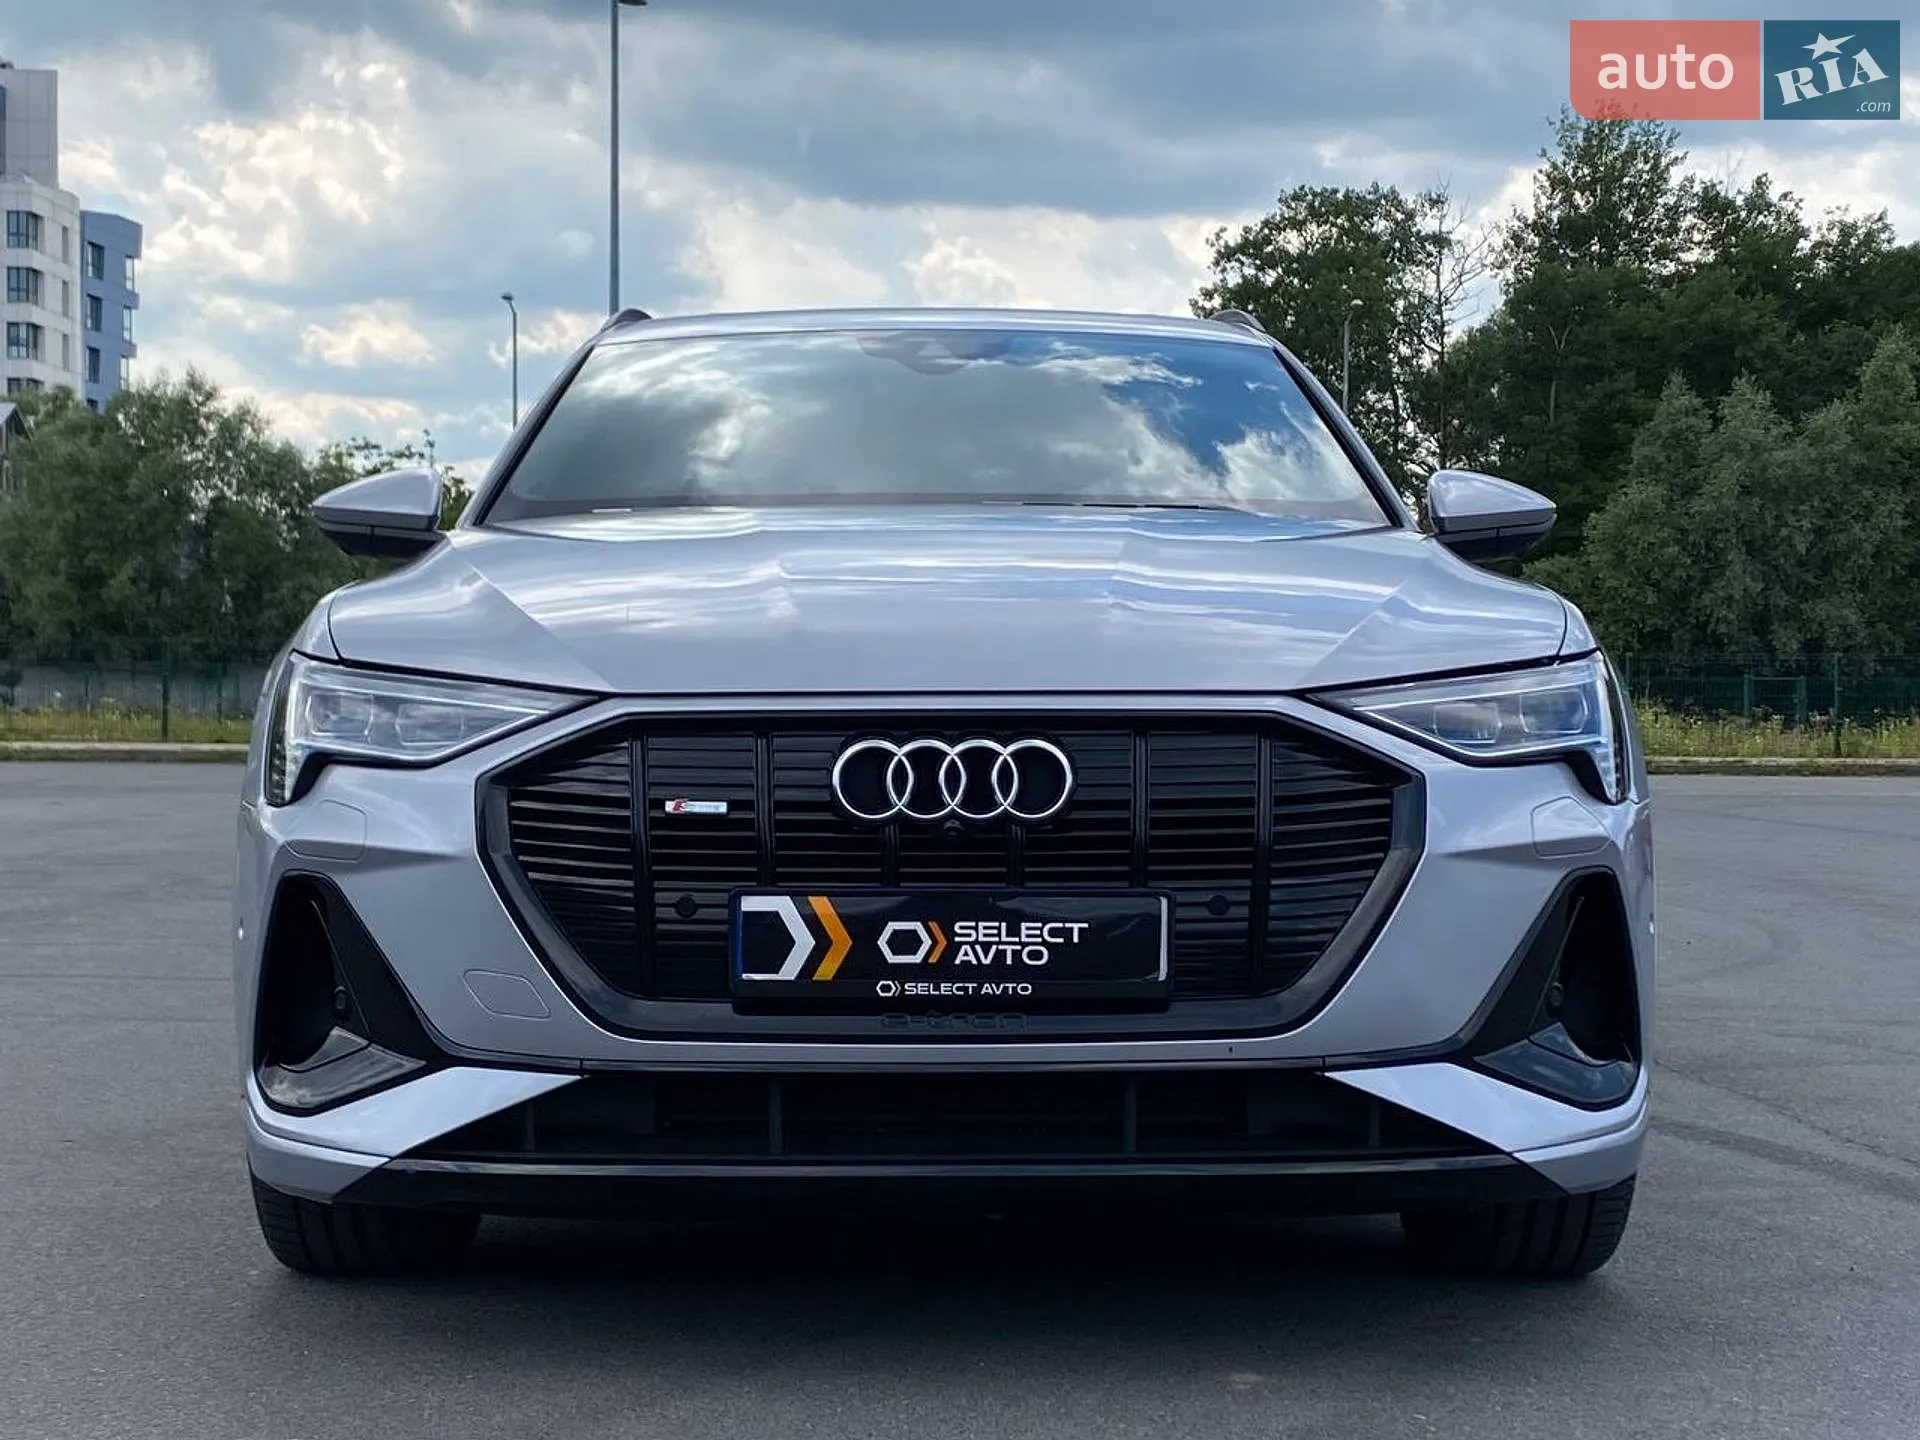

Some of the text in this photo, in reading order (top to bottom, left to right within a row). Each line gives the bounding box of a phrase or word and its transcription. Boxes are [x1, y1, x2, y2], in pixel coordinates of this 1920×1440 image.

[954, 922, 1089, 943] SELECT
[954, 945, 1049, 965] AVTO
[904, 982, 1032, 996] SELECT AVTO
